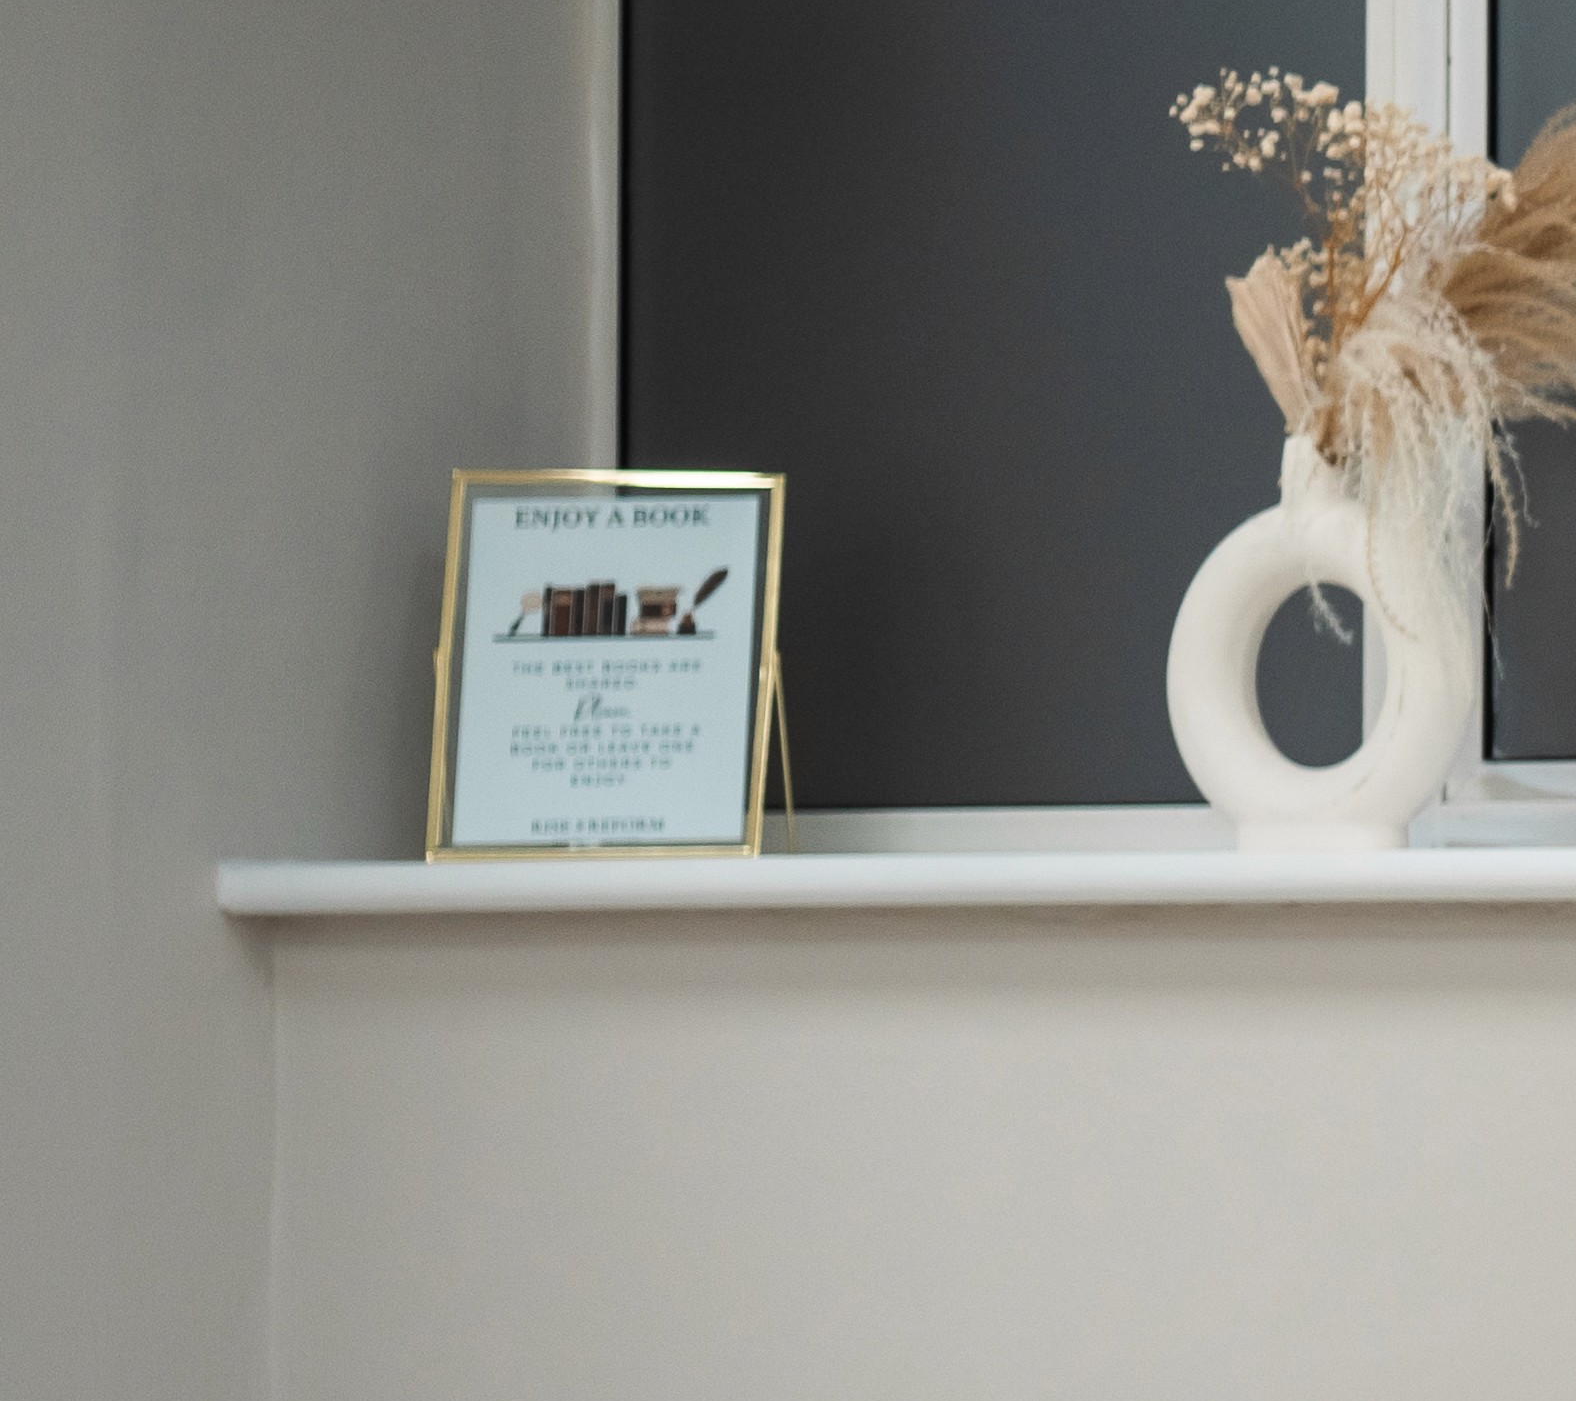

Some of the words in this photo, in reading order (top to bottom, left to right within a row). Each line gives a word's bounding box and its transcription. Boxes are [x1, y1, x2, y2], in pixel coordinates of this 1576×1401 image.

[515, 505, 600, 533] ENJOY
[607, 506, 625, 529] A
[633, 504, 710, 529] BOOK
